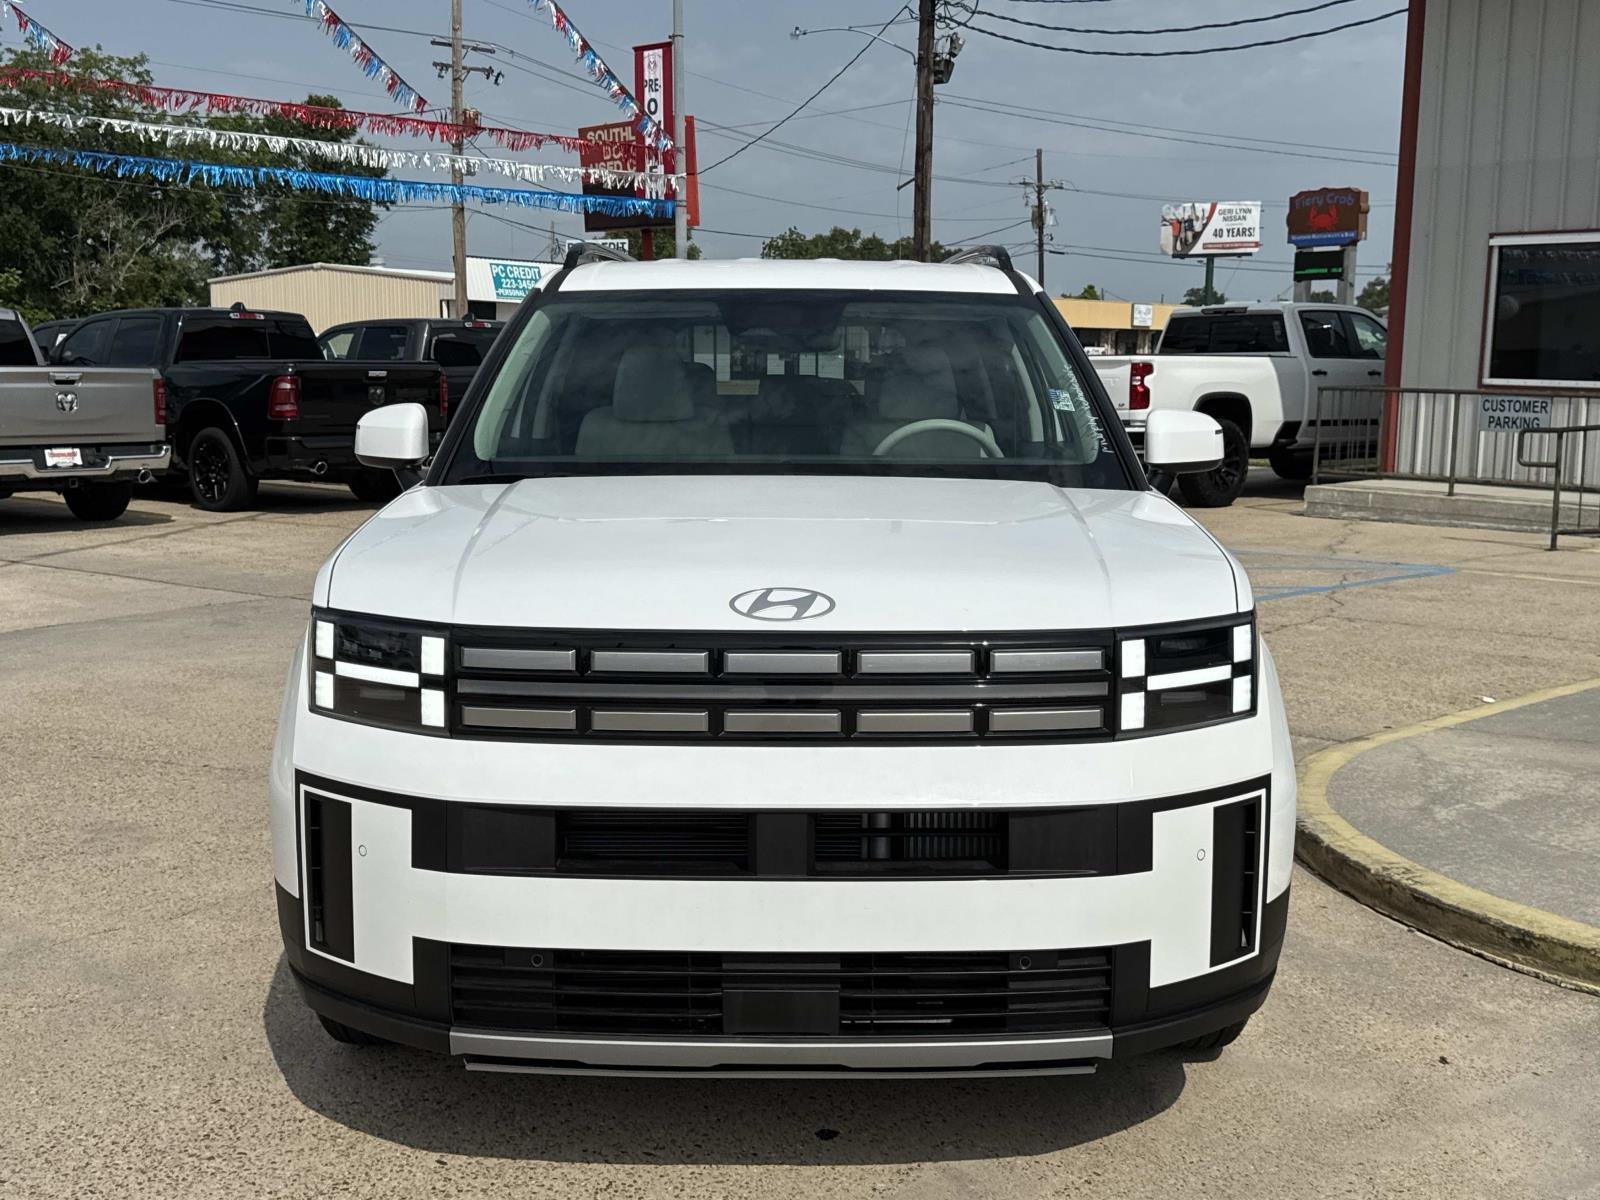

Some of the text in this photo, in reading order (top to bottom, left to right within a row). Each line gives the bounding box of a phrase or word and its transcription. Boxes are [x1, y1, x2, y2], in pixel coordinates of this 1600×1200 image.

[644, 78, 661, 93] PRE-
[1235, 207, 1252, 215] LYNN
[1212, 227, 1256, 238] 40 YEARS!
[491, 264, 540, 280] PC CREDIT
[1482, 399, 1549, 414] CUSTOMER
[1487, 415, 1540, 430] PARKING
